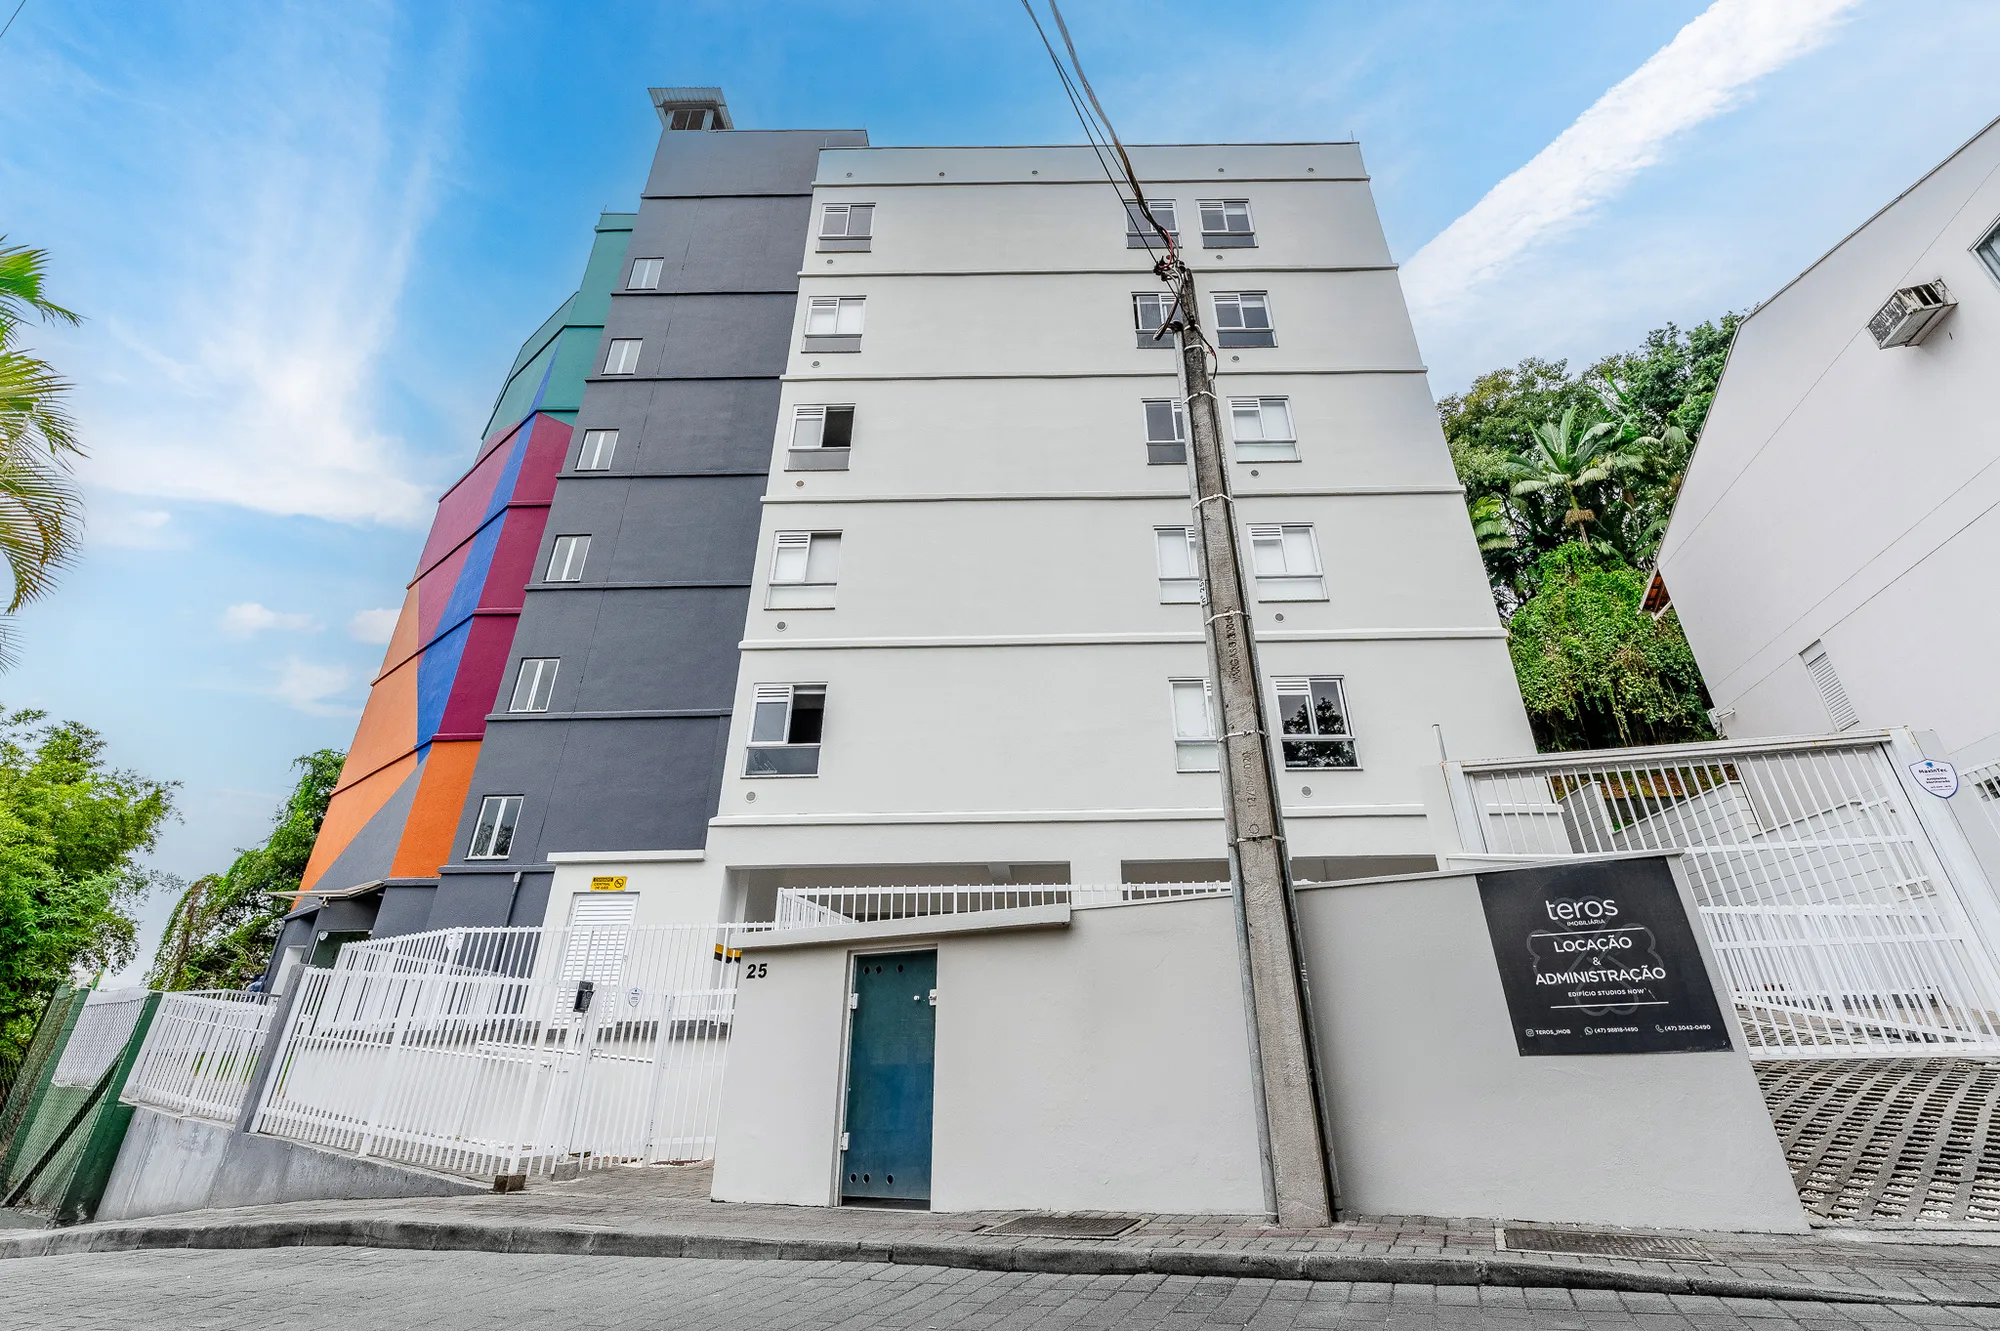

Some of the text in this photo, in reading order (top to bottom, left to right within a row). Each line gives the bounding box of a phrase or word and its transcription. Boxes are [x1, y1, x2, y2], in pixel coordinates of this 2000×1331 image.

[1545, 899, 1619, 920] teros
[1554, 935, 1632, 952] LOCAÇÃO
[1592, 956, 1602, 966] &
[745, 962, 768, 979] 25
[1536, 965, 1666, 985] ADMINISTRAÇÃO
[1568, 989, 1597, 997] EDIFÍCIO
